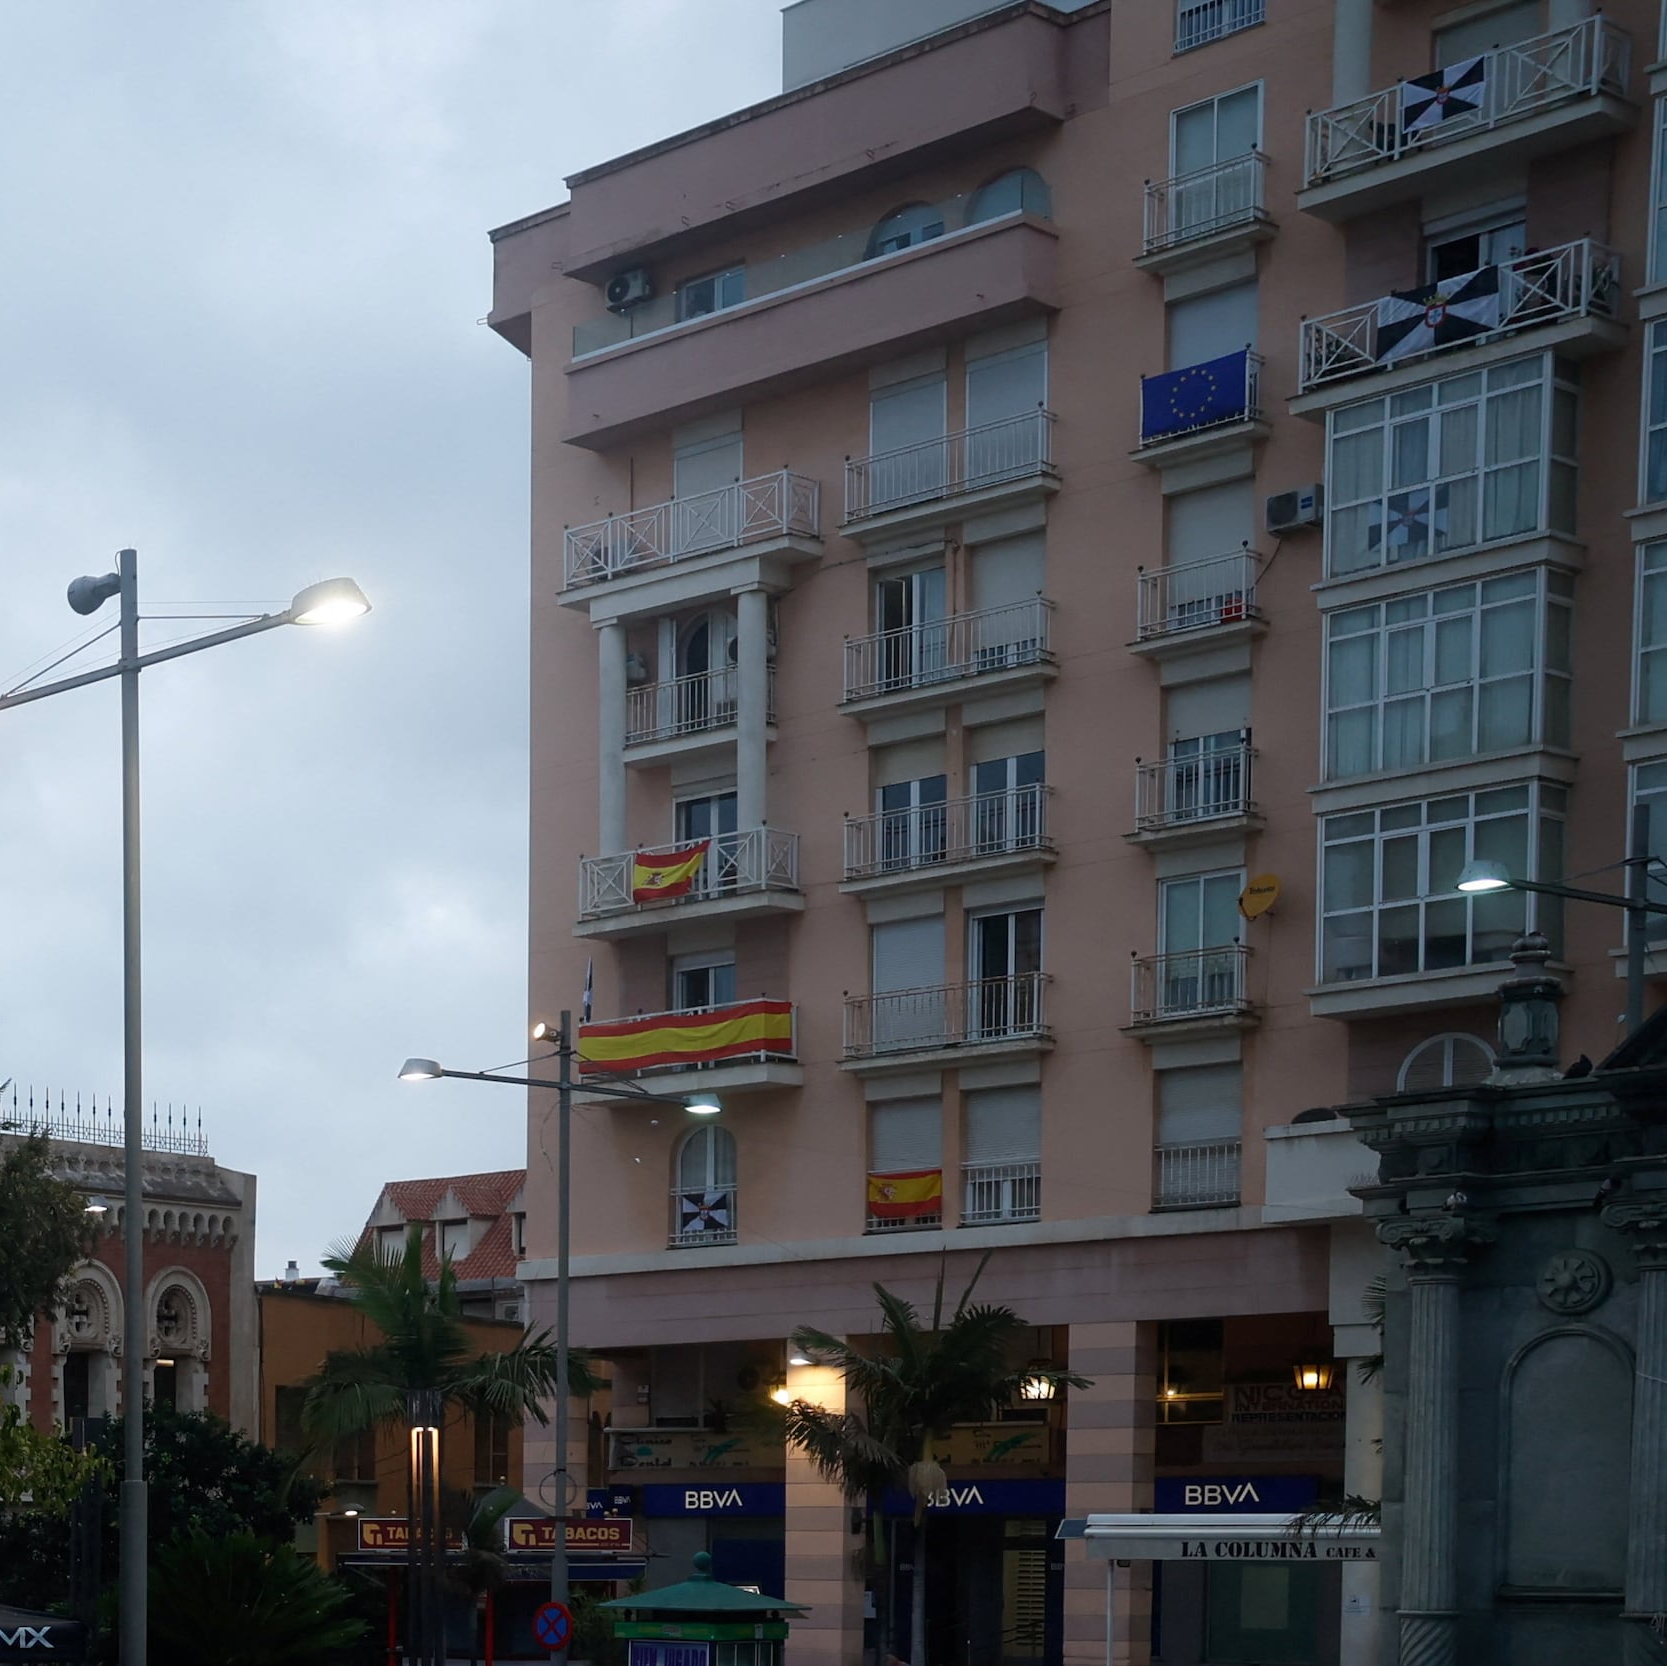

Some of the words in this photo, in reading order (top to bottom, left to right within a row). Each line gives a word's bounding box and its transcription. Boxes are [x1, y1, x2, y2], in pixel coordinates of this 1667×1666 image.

[684, 1488, 744, 1510] BBVA
[1184, 1482, 1260, 1507] BBVA
[586, 1501, 604, 1511] BVA
[1181, 1541, 1207, 1558] LA
[1215, 1541, 1317, 1558] COLUMNA
[1325, 1547, 1361, 1558] CAFE
[1365, 1547, 1376, 1558] &
